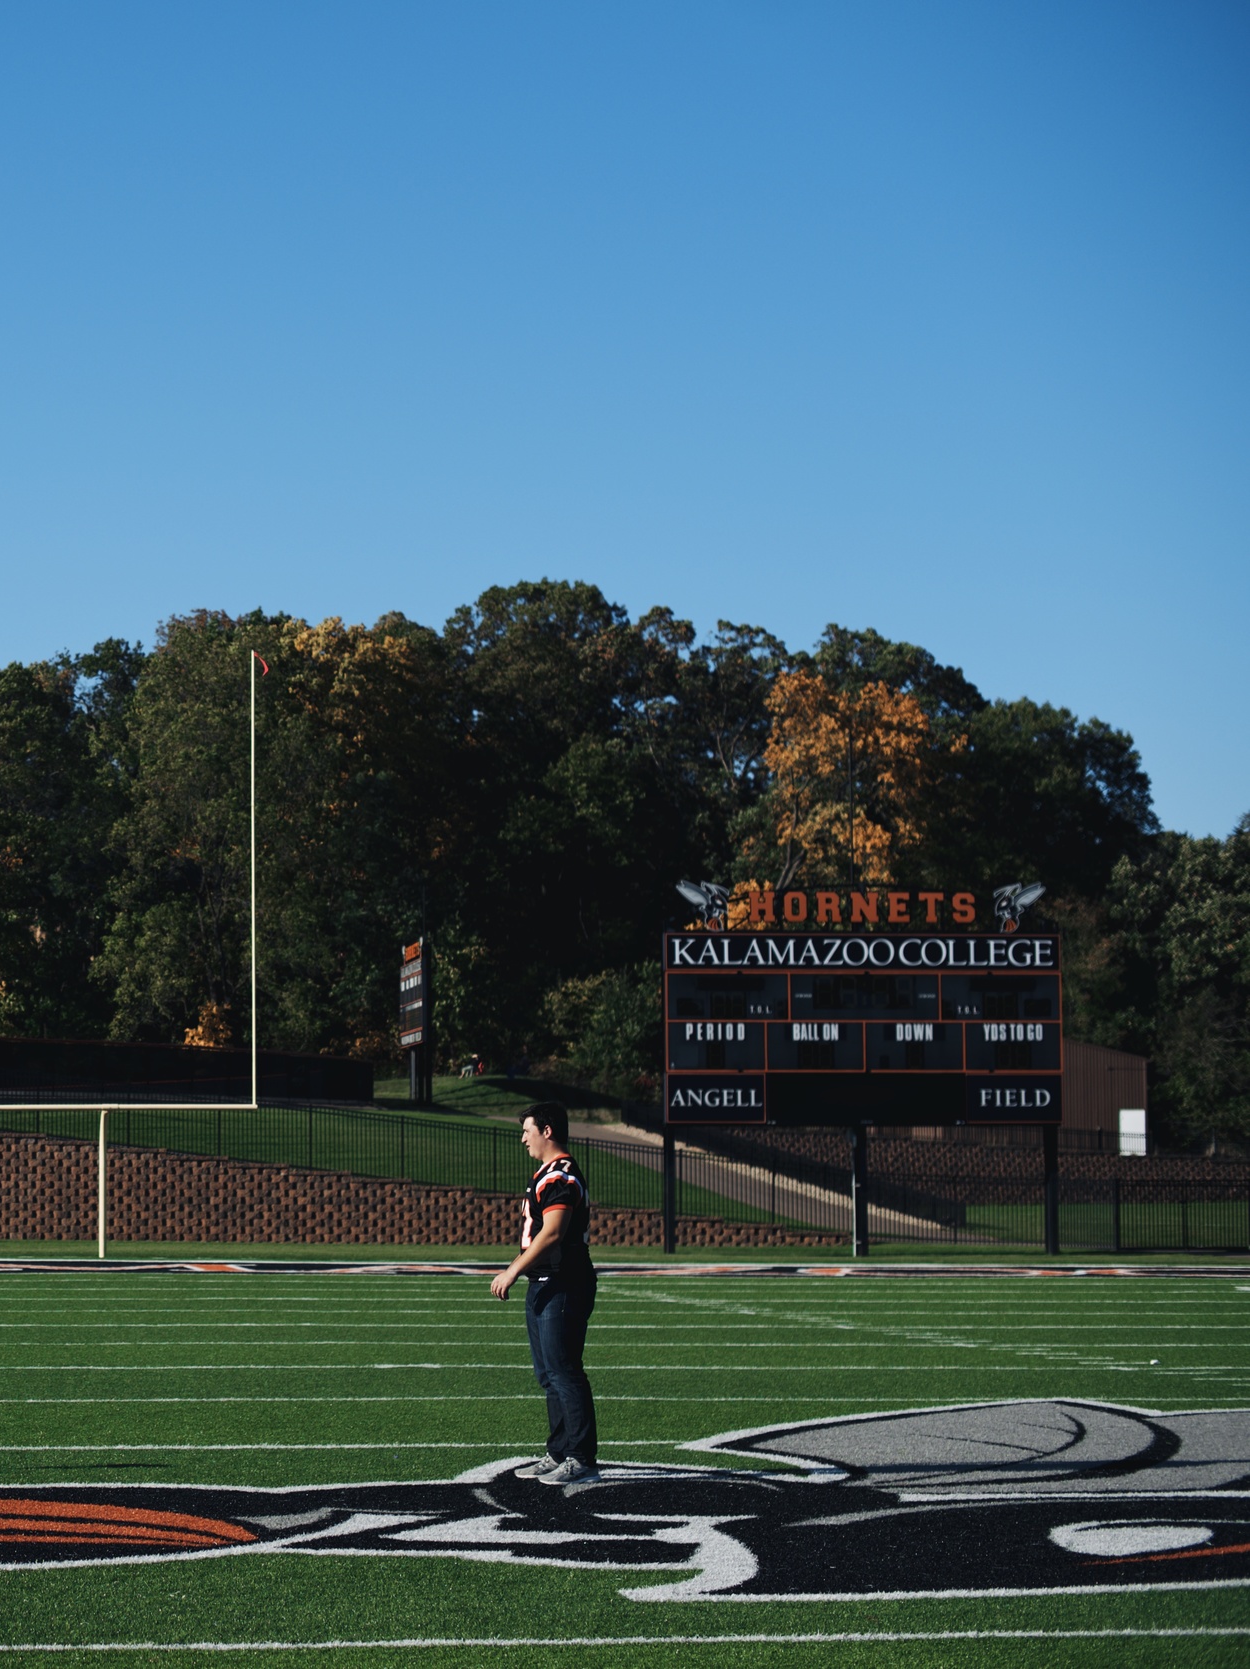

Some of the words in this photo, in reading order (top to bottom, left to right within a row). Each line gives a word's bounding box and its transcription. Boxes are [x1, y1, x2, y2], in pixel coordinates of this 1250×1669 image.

[750, 891, 976, 924] HORNETS
[672, 937, 895, 967] KALAMAZOO
[898, 938, 1053, 967] COLLEGE
[685, 1022, 746, 1041] PERIOD
[792, 1023, 819, 1042] BALL
[822, 1023, 839, 1042] ON
[896, 1023, 933, 1042] DOWN
[983, 1023, 1007, 1042] YDS
[1009, 1023, 1025, 1042] TO
[1026, 1023, 1043, 1042] GO
[670, 1088, 763, 1107] ANGELL
[980, 1088, 1051, 1107] FIELD
